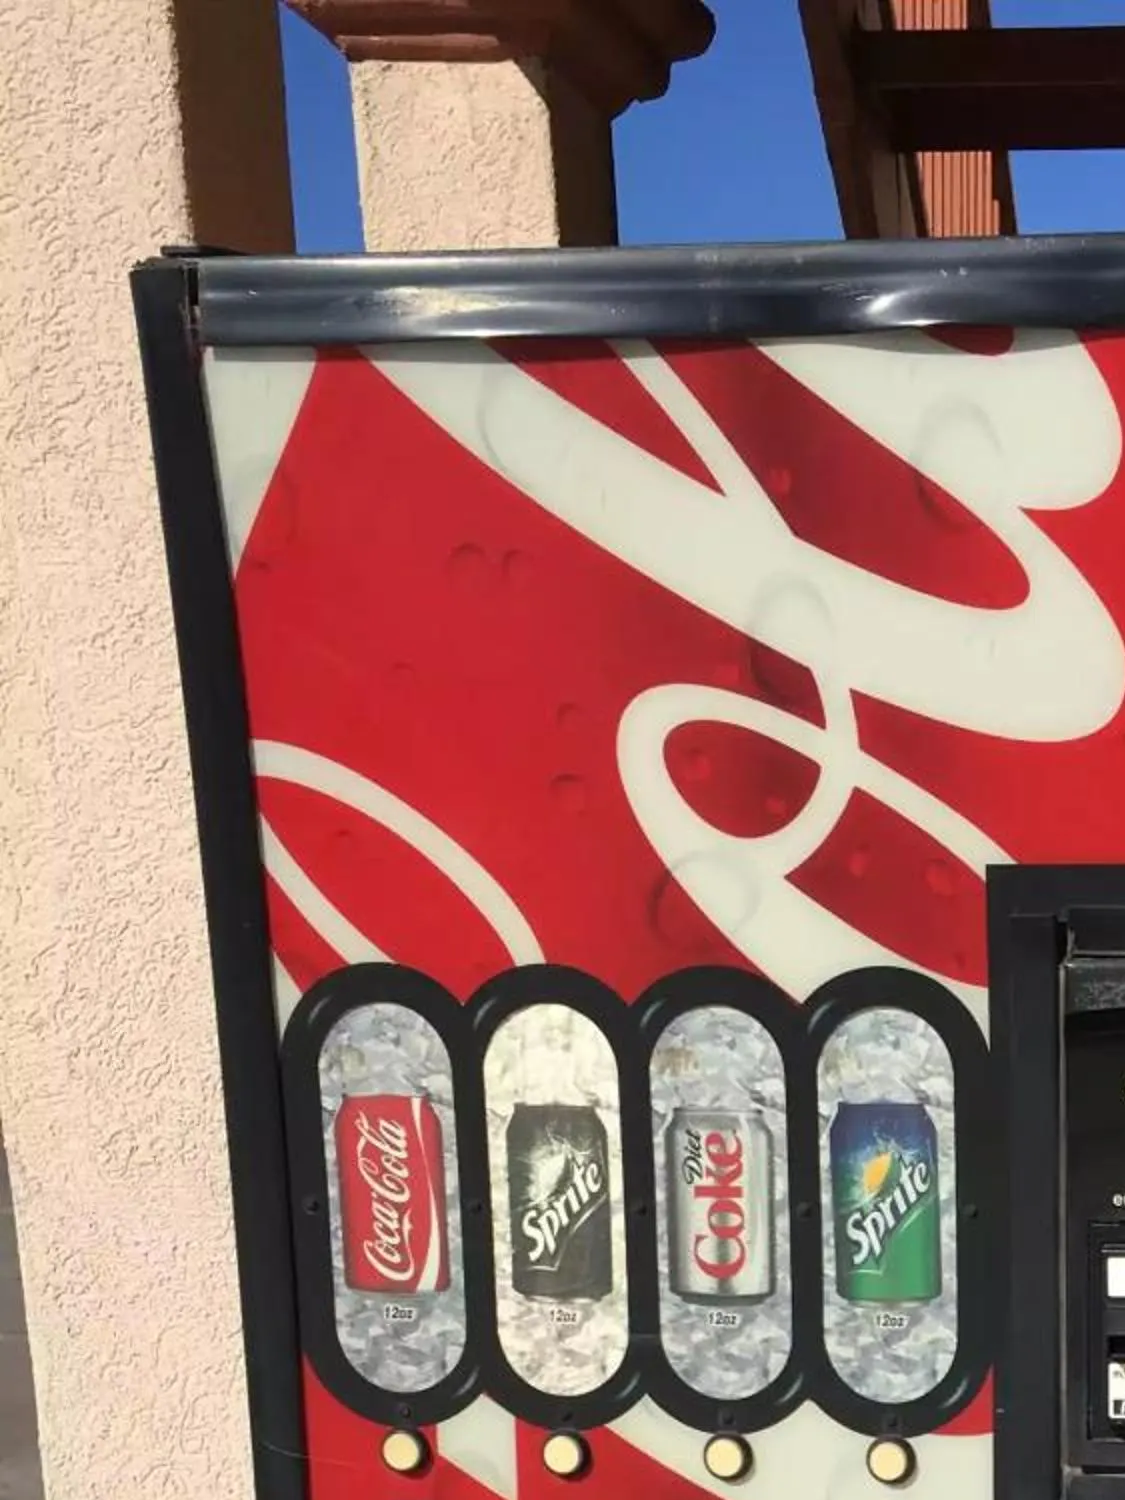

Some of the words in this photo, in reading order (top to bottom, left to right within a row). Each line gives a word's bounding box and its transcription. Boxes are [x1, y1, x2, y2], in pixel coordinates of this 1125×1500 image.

[354, 1110, 414, 1281] Coca-Cola
[521, 1157, 602, 1262] Sprite
[682, 1129, 702, 1185] Diet
[693, 1131, 746, 1280] Coke
[845, 1155, 932, 1265] Sprite
